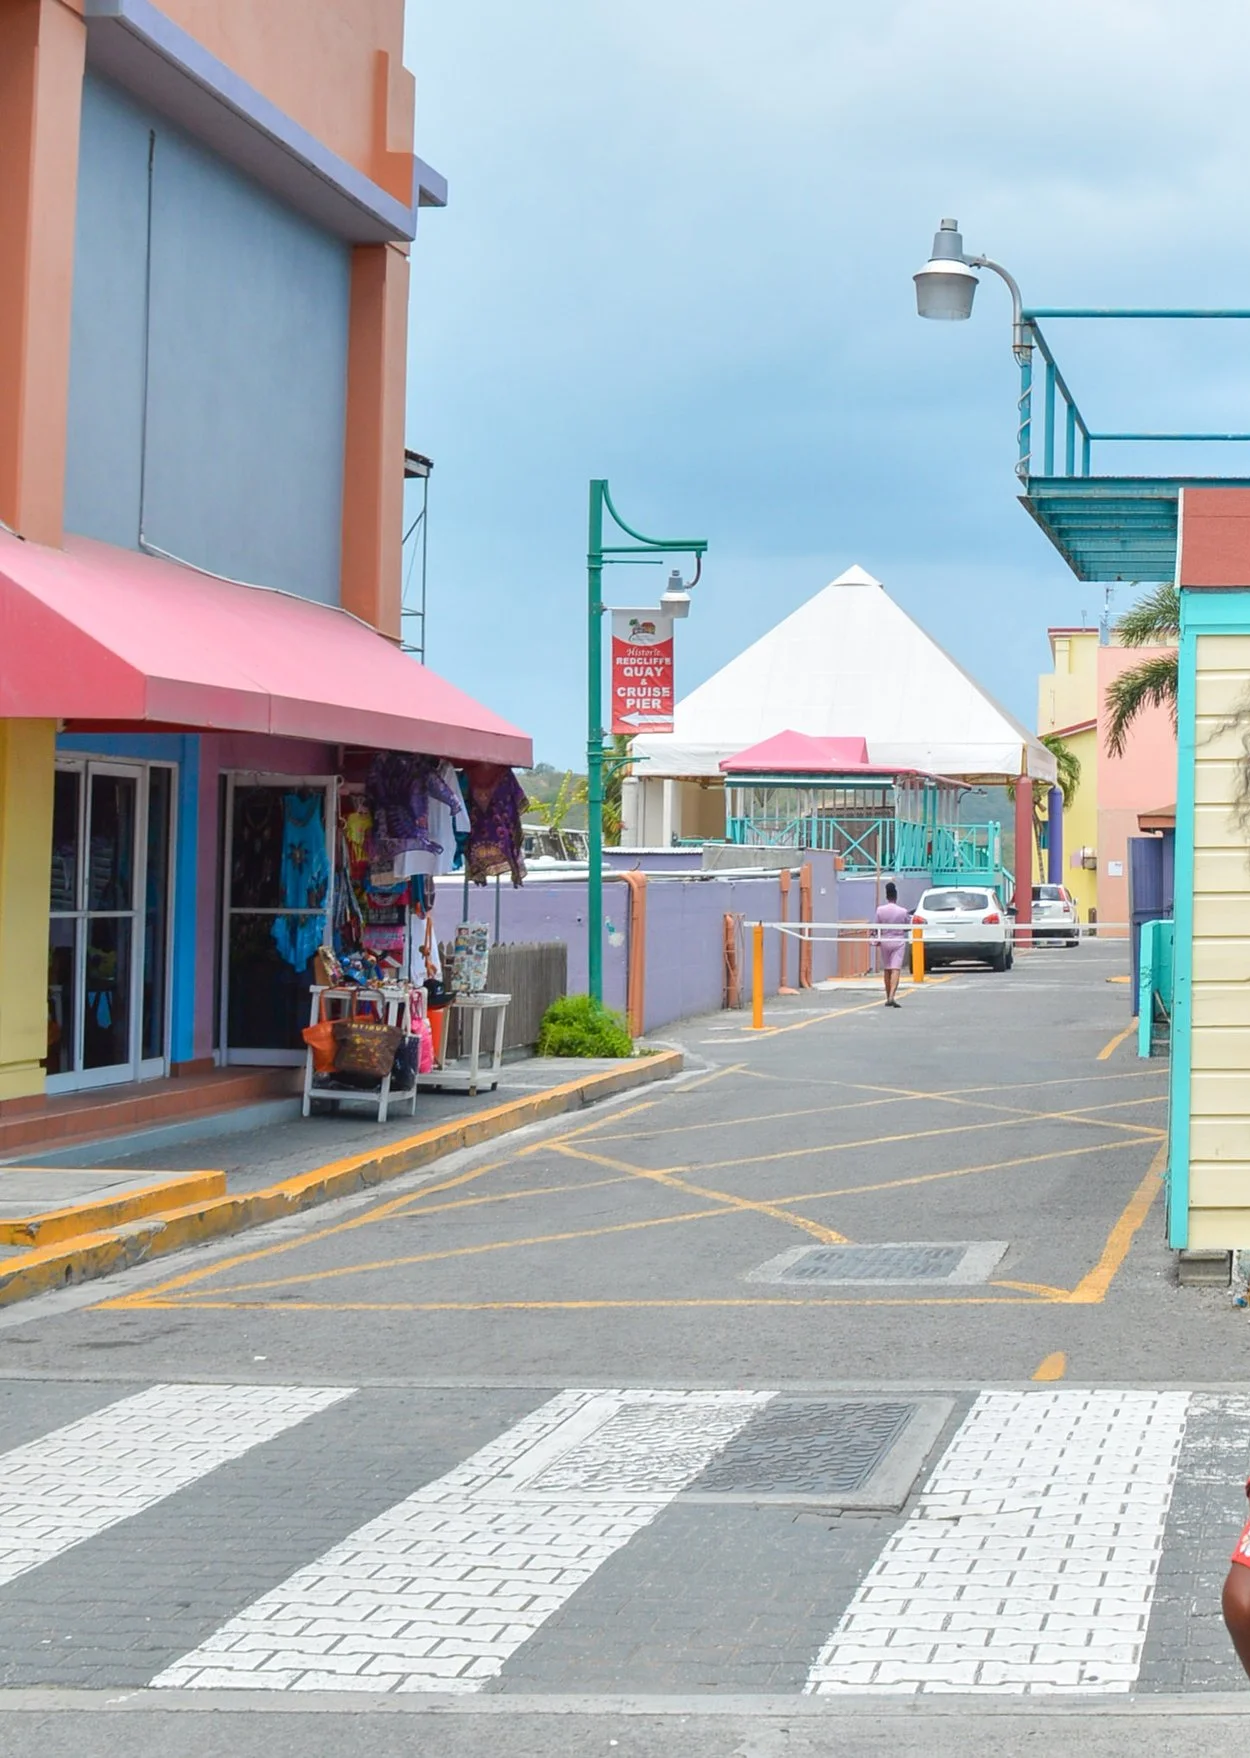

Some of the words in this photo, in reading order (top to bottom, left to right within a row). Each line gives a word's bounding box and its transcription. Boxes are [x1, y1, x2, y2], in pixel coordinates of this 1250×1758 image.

[626, 648, 661, 656] Historic
[615, 657, 672, 665] REDCLIFFE
[623, 666, 664, 677] QUAY
[616, 686, 671, 697] CRUISE
[626, 698, 662, 709] PIER
